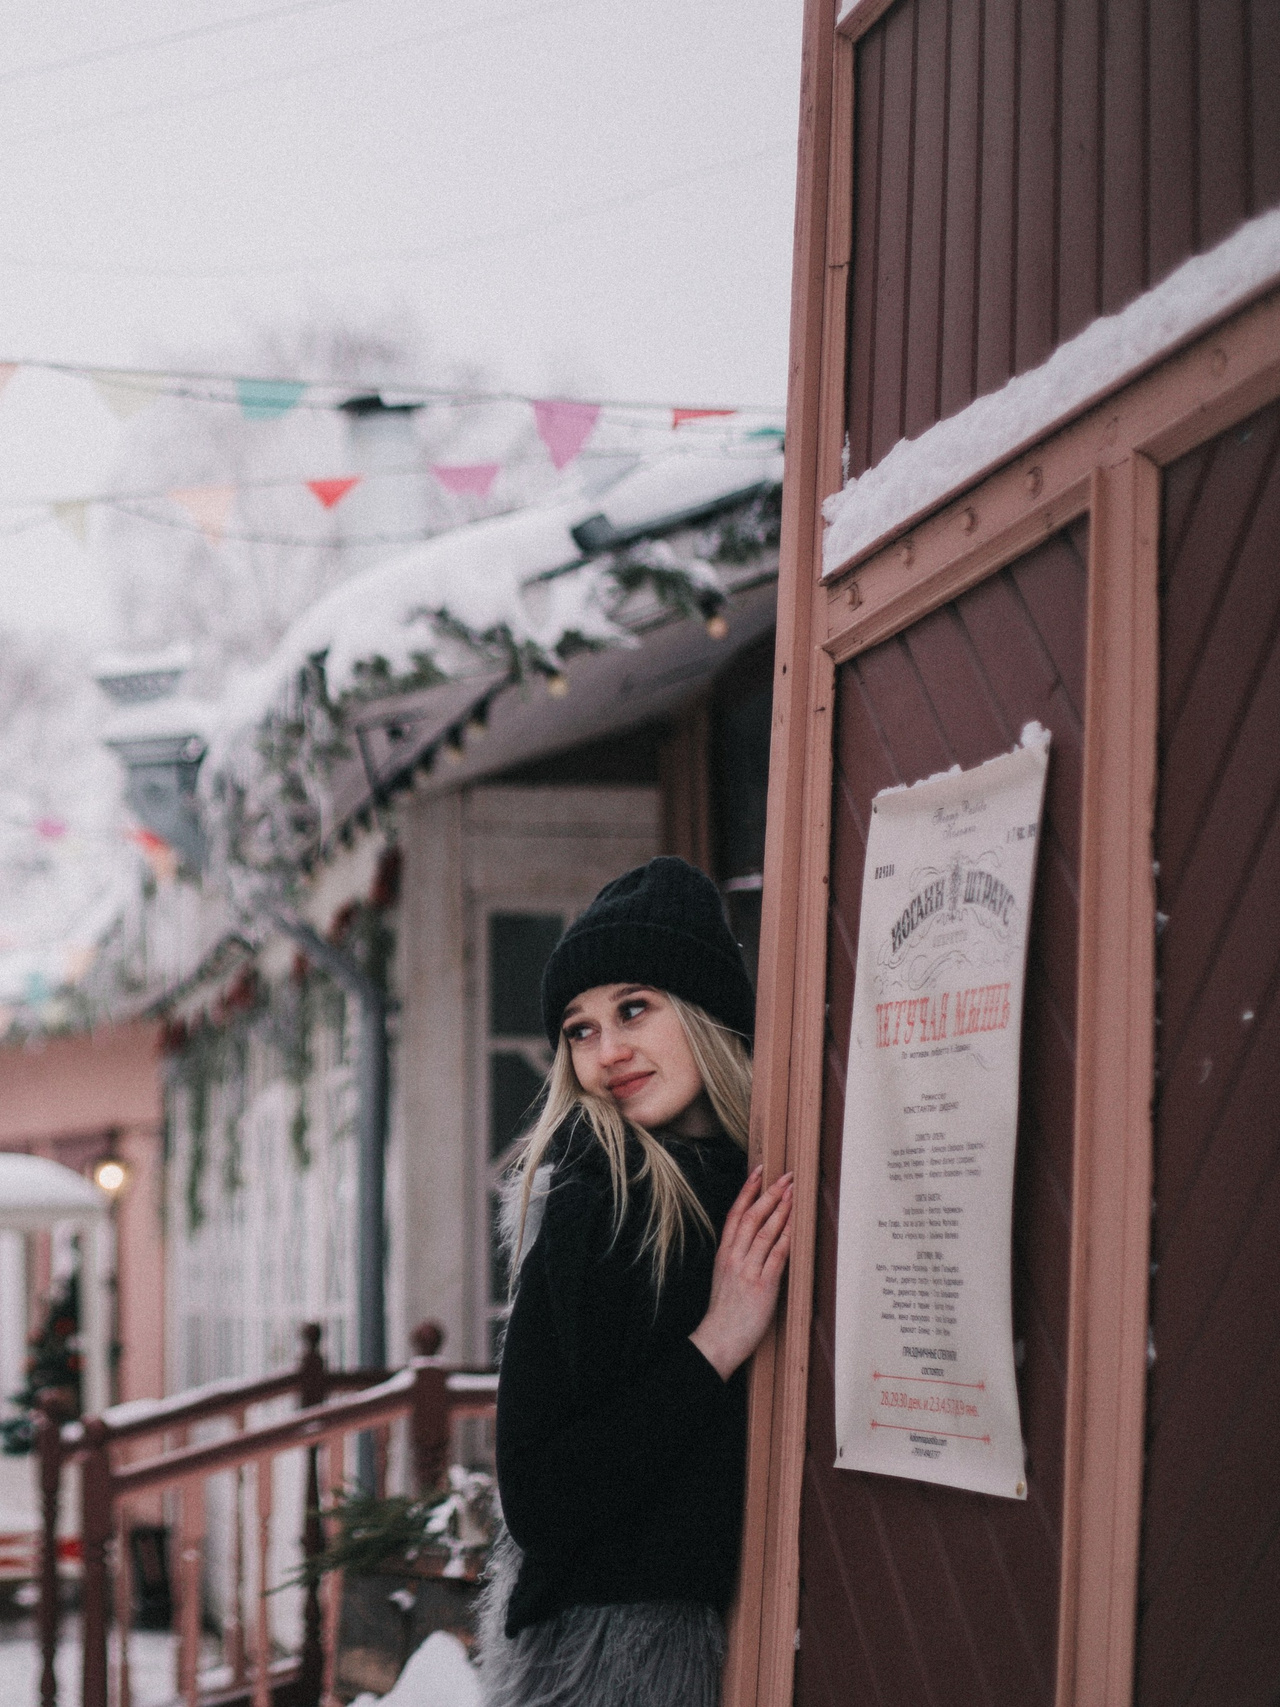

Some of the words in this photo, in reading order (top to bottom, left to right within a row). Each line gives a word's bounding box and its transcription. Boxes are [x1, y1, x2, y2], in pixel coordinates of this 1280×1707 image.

[890, 877, 946, 953] ИОГАНН
[963, 870, 1016, 926] ШТРАУС
[875, 991, 950, 1049] ЛЕТУЧАЯ
[953, 982, 1011, 1038] МЫШЬ
